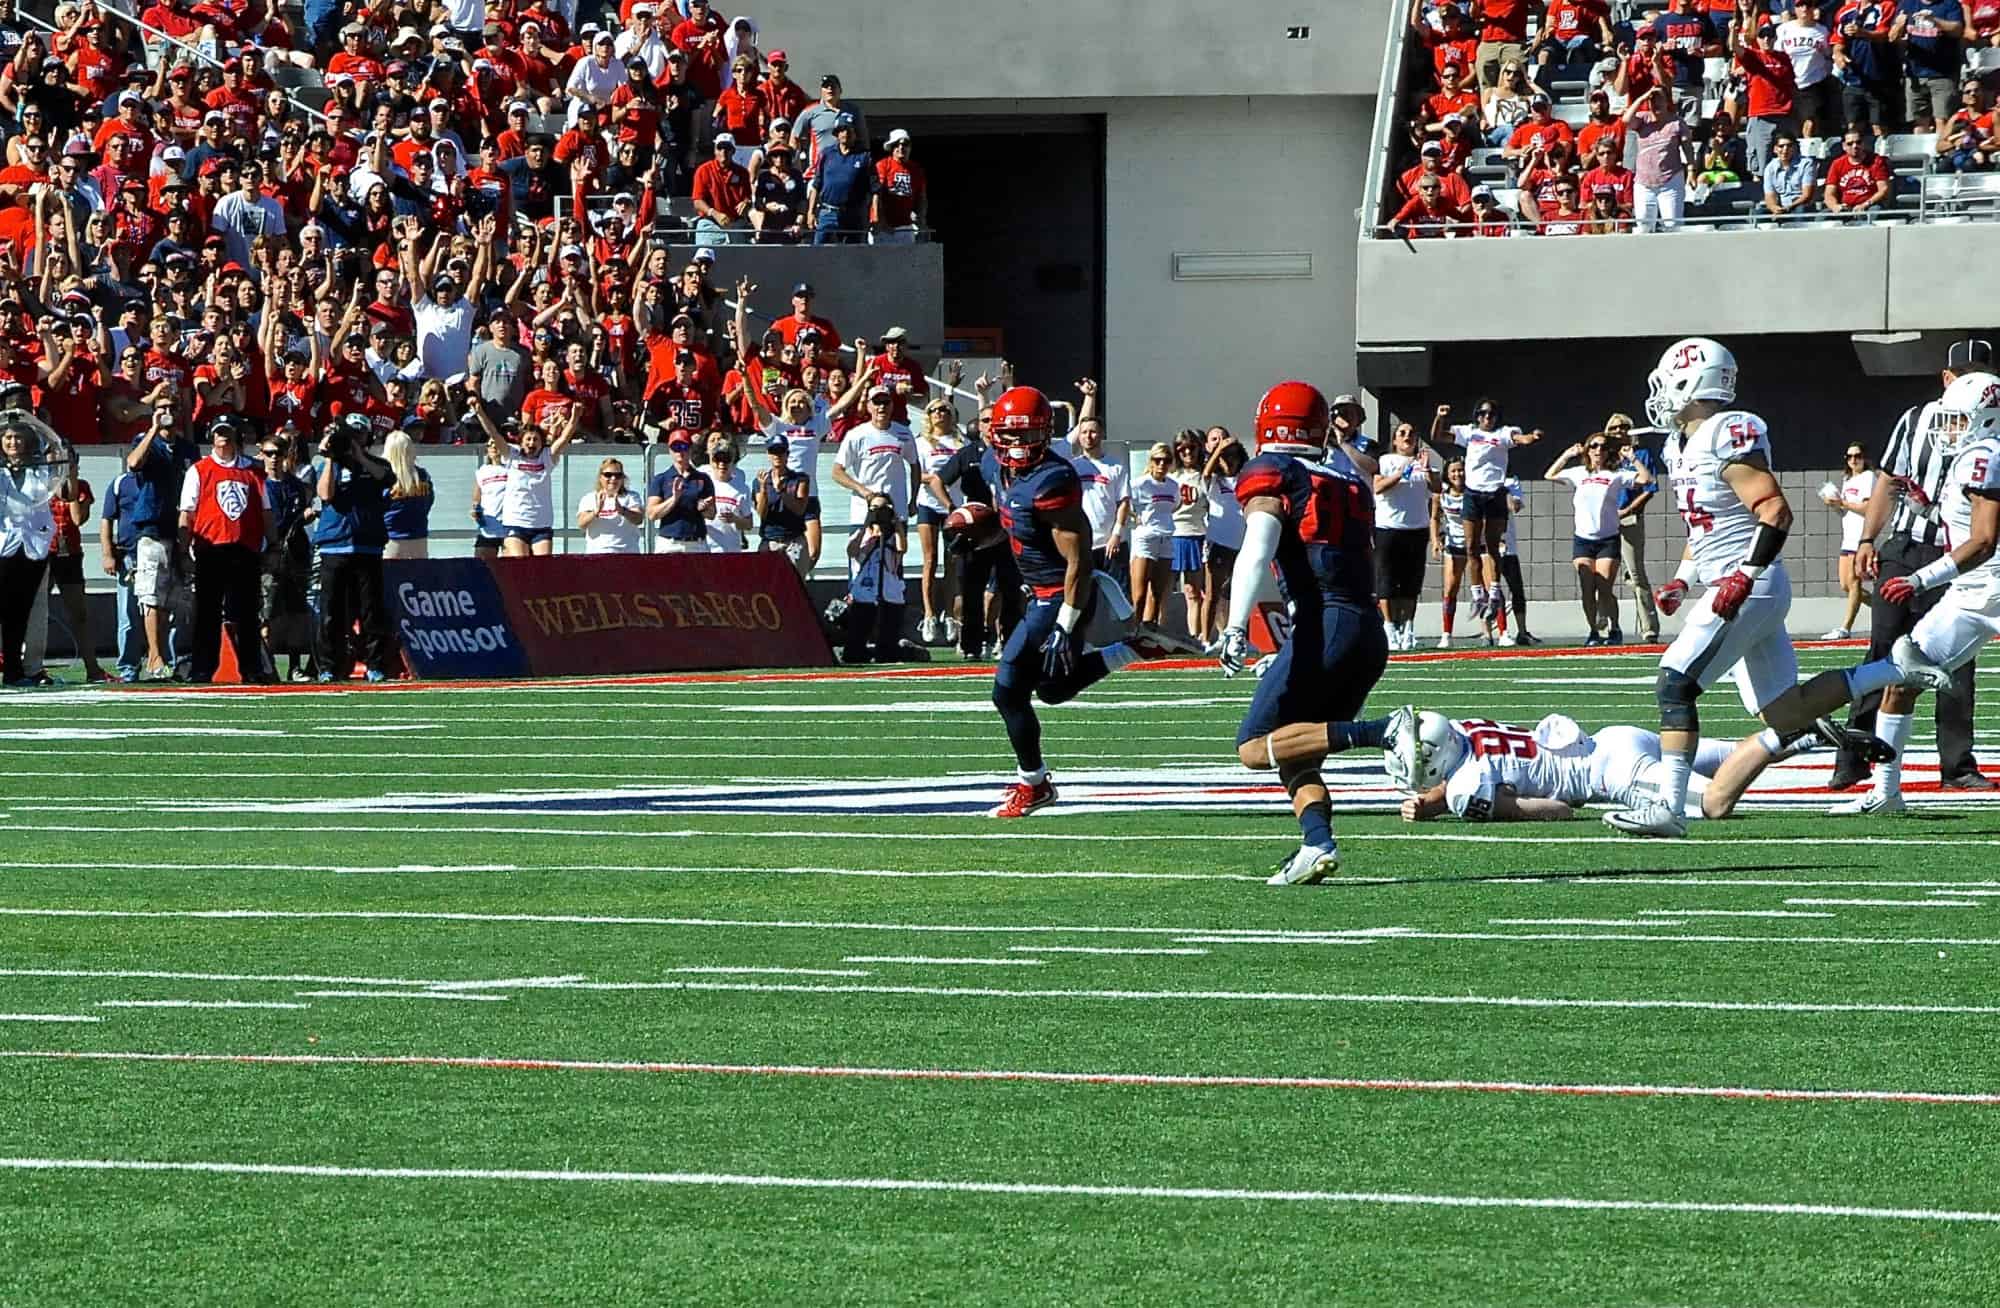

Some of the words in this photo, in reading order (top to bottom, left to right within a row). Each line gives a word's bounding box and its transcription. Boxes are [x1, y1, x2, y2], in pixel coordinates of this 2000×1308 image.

[1730, 421, 1760, 449] 54
[1971, 458, 1989, 482] 5
[399, 582, 476, 617] Game
[525, 592, 664, 638] WELLS
[662, 591, 783, 632] FARGO
[400, 618, 508, 660] Sponsor
